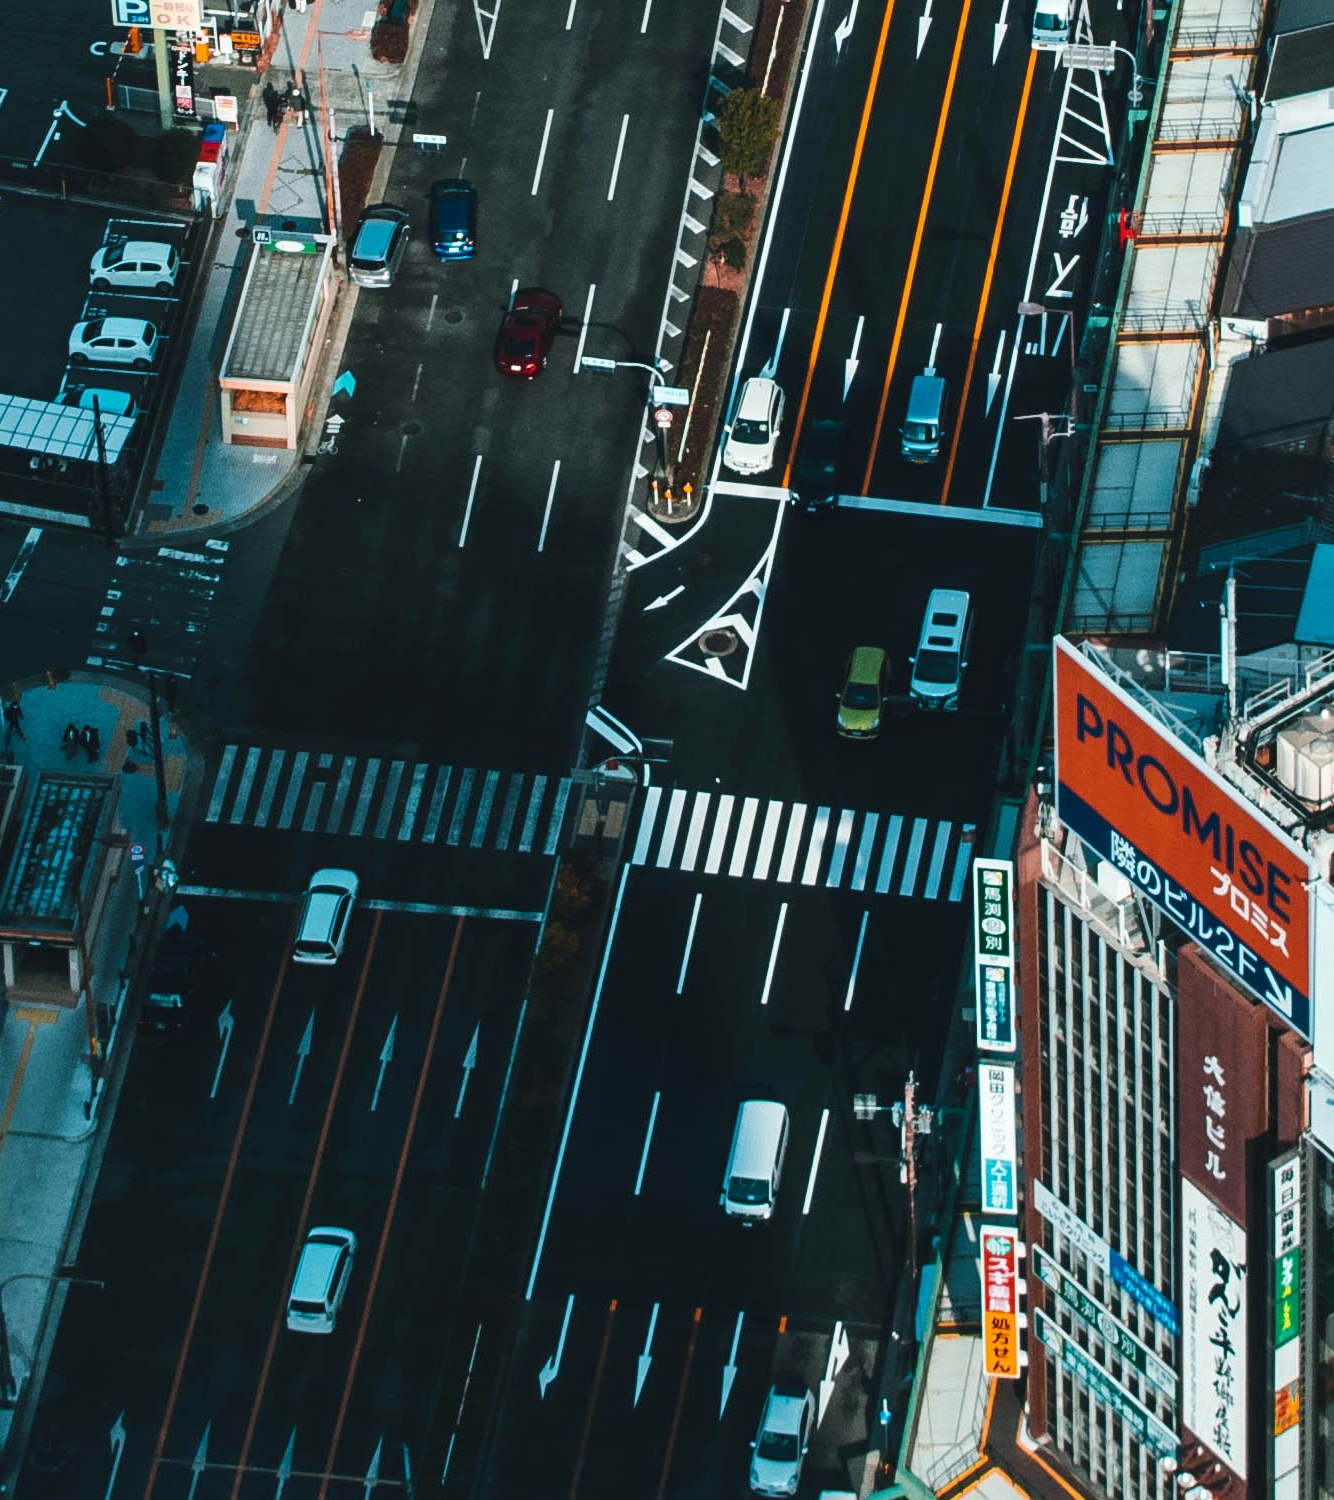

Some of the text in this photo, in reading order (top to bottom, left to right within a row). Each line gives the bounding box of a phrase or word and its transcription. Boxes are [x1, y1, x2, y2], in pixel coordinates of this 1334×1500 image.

[131, 15, 150, 24] 24H
[1077, 693, 1292, 924] PROMISE
[1110, 830, 1263, 979] 隣のビル2F
[1210, 866, 1290, 958] プロミス
[991, 1159, 1008, 1209] 人工透析
[992, 1317, 1011, 1373] 処方せん
